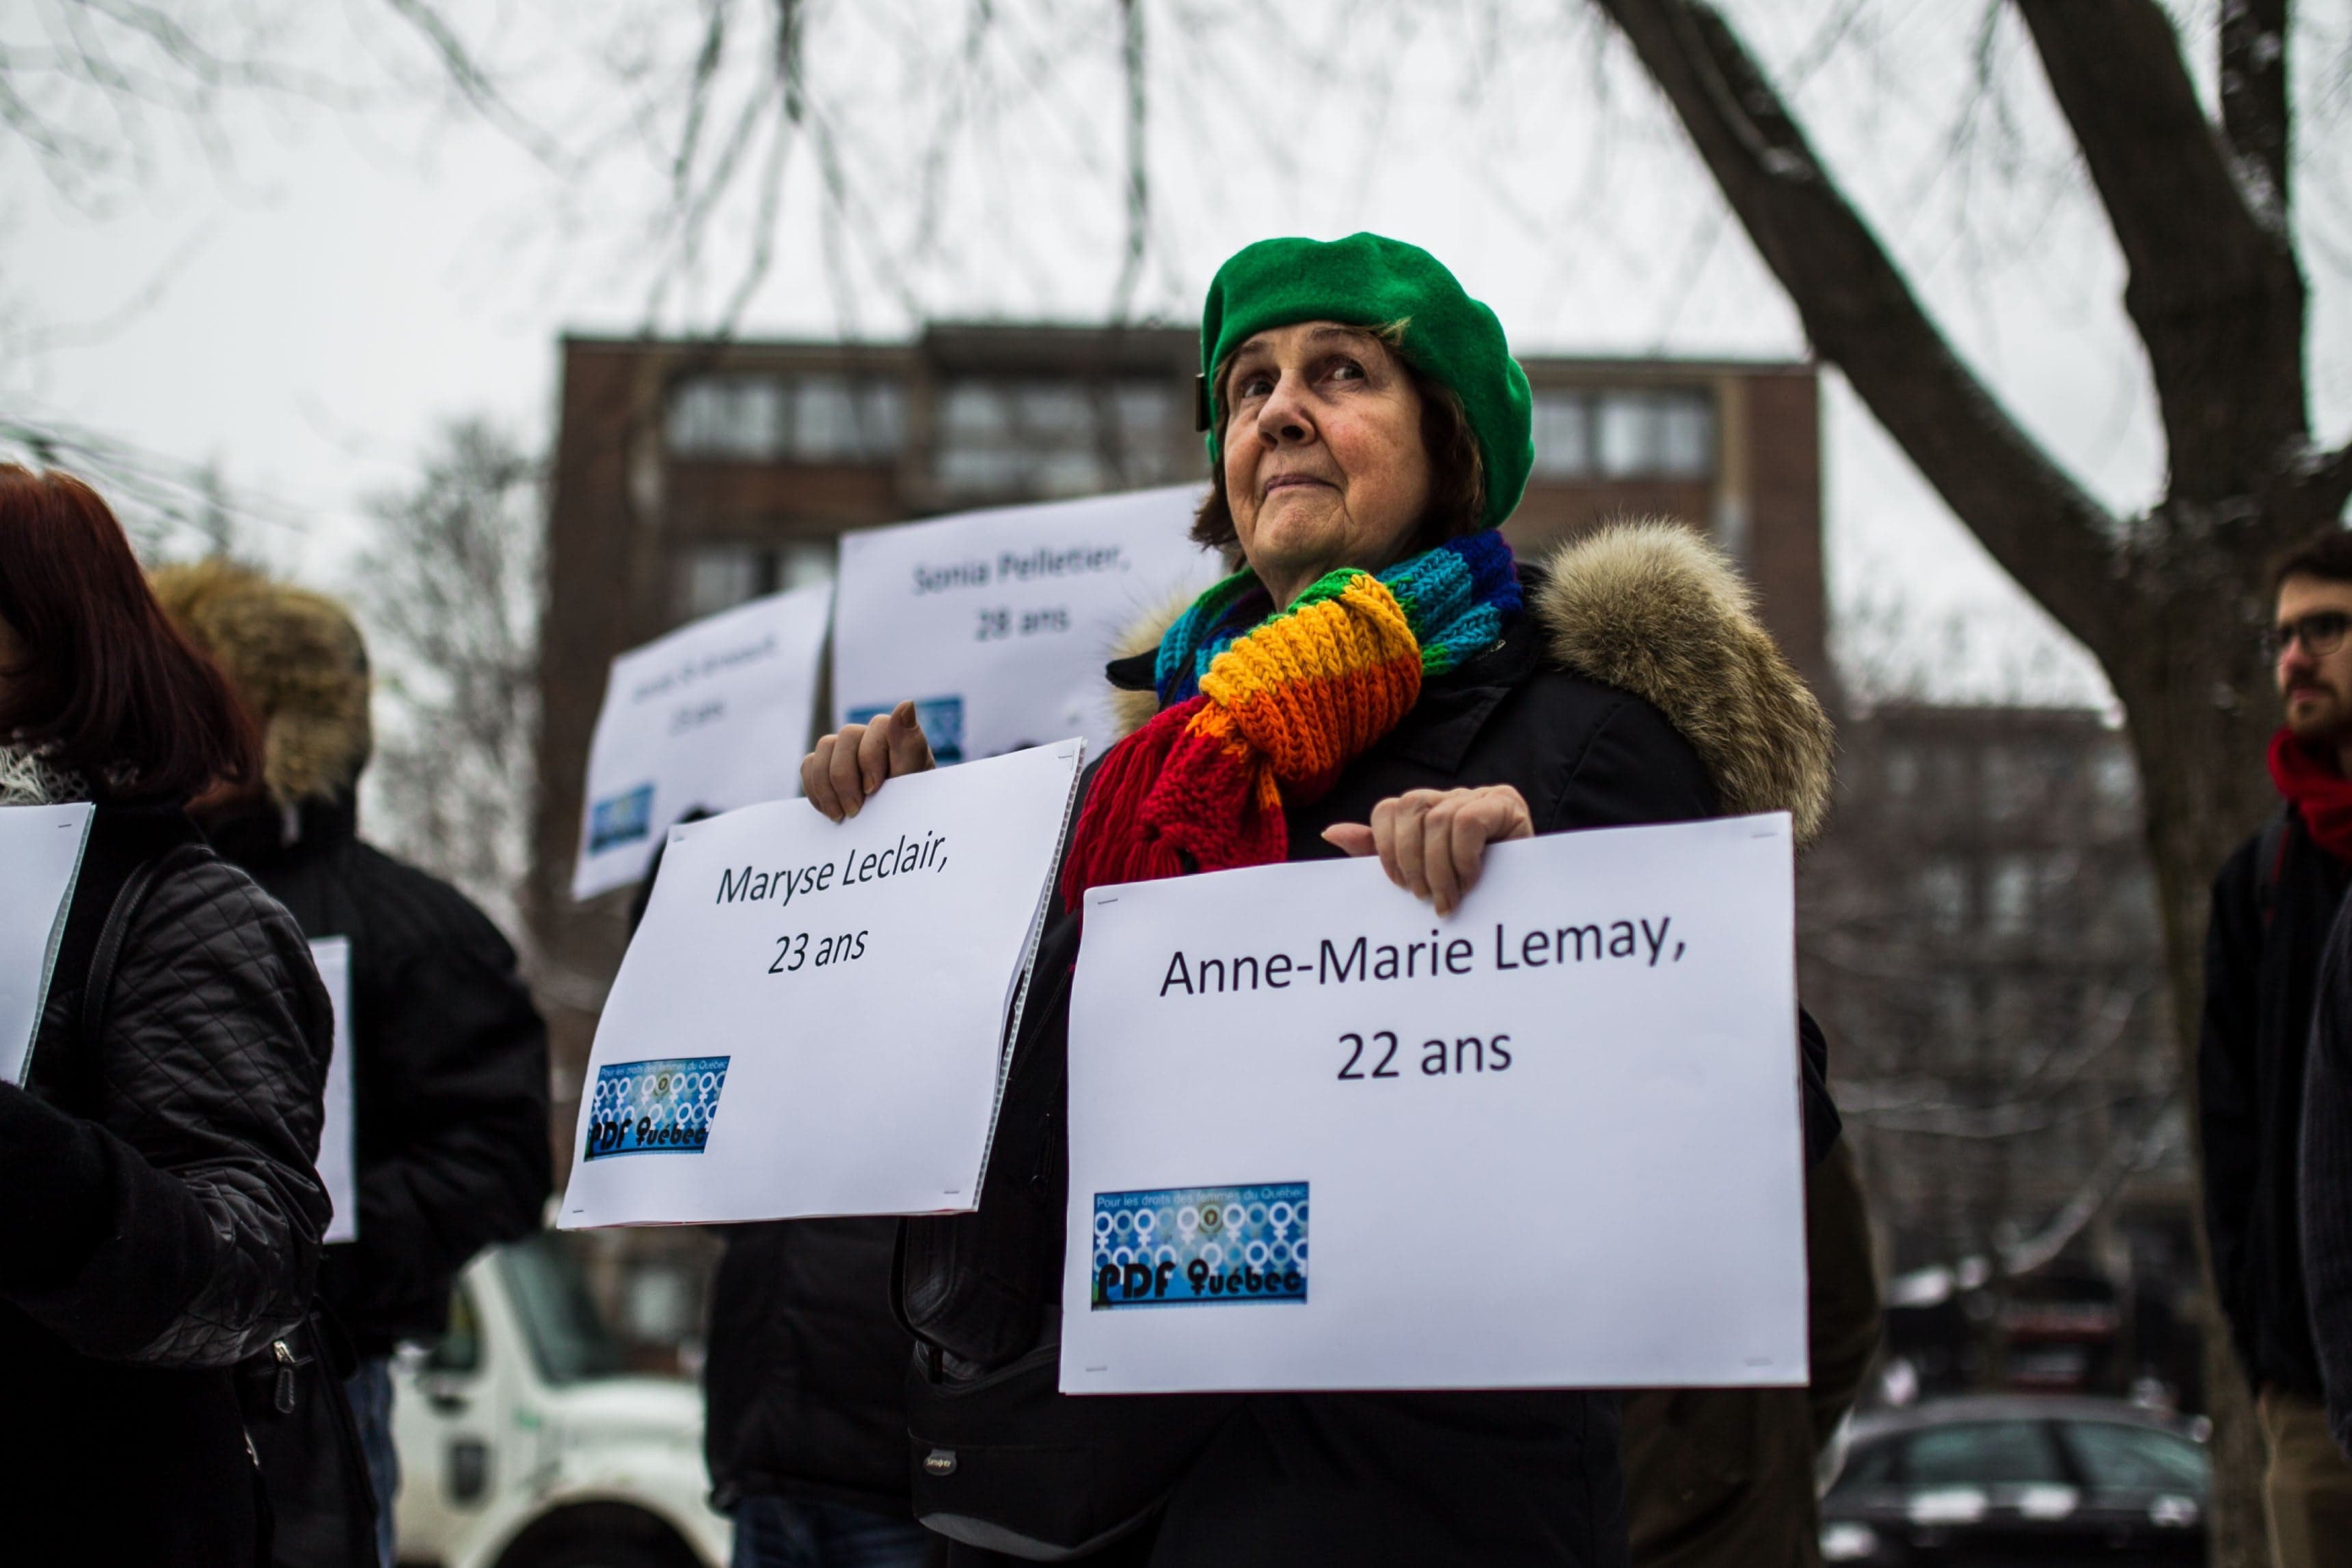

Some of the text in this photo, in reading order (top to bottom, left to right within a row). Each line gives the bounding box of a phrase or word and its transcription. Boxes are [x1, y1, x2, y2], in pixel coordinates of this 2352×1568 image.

[912, 545, 1131, 595] Sonia Pelletier,
[973, 608, 1071, 641] 28 ans
[716, 830, 948, 906] Maryse Leclair,
[768, 930, 869, 975] 23 ans
[1159, 916, 1686, 997] Anne-Marie Lemay,
[687, 1061, 697, 1071] du
[1337, 1031, 1513, 1081] 22 ans
[591, 1118, 632, 1150] PDF
[1097, 1197, 1120, 1208] Pour
[1124, 1195, 1139, 1206] les
[1141, 1193, 1171, 1206] droits
[1174, 1192, 1193, 1204] des
[1197, 1190, 1241, 1204] femmes
[1243, 1189, 1258, 1201] du
[1098, 1261, 1176, 1299] PDF
